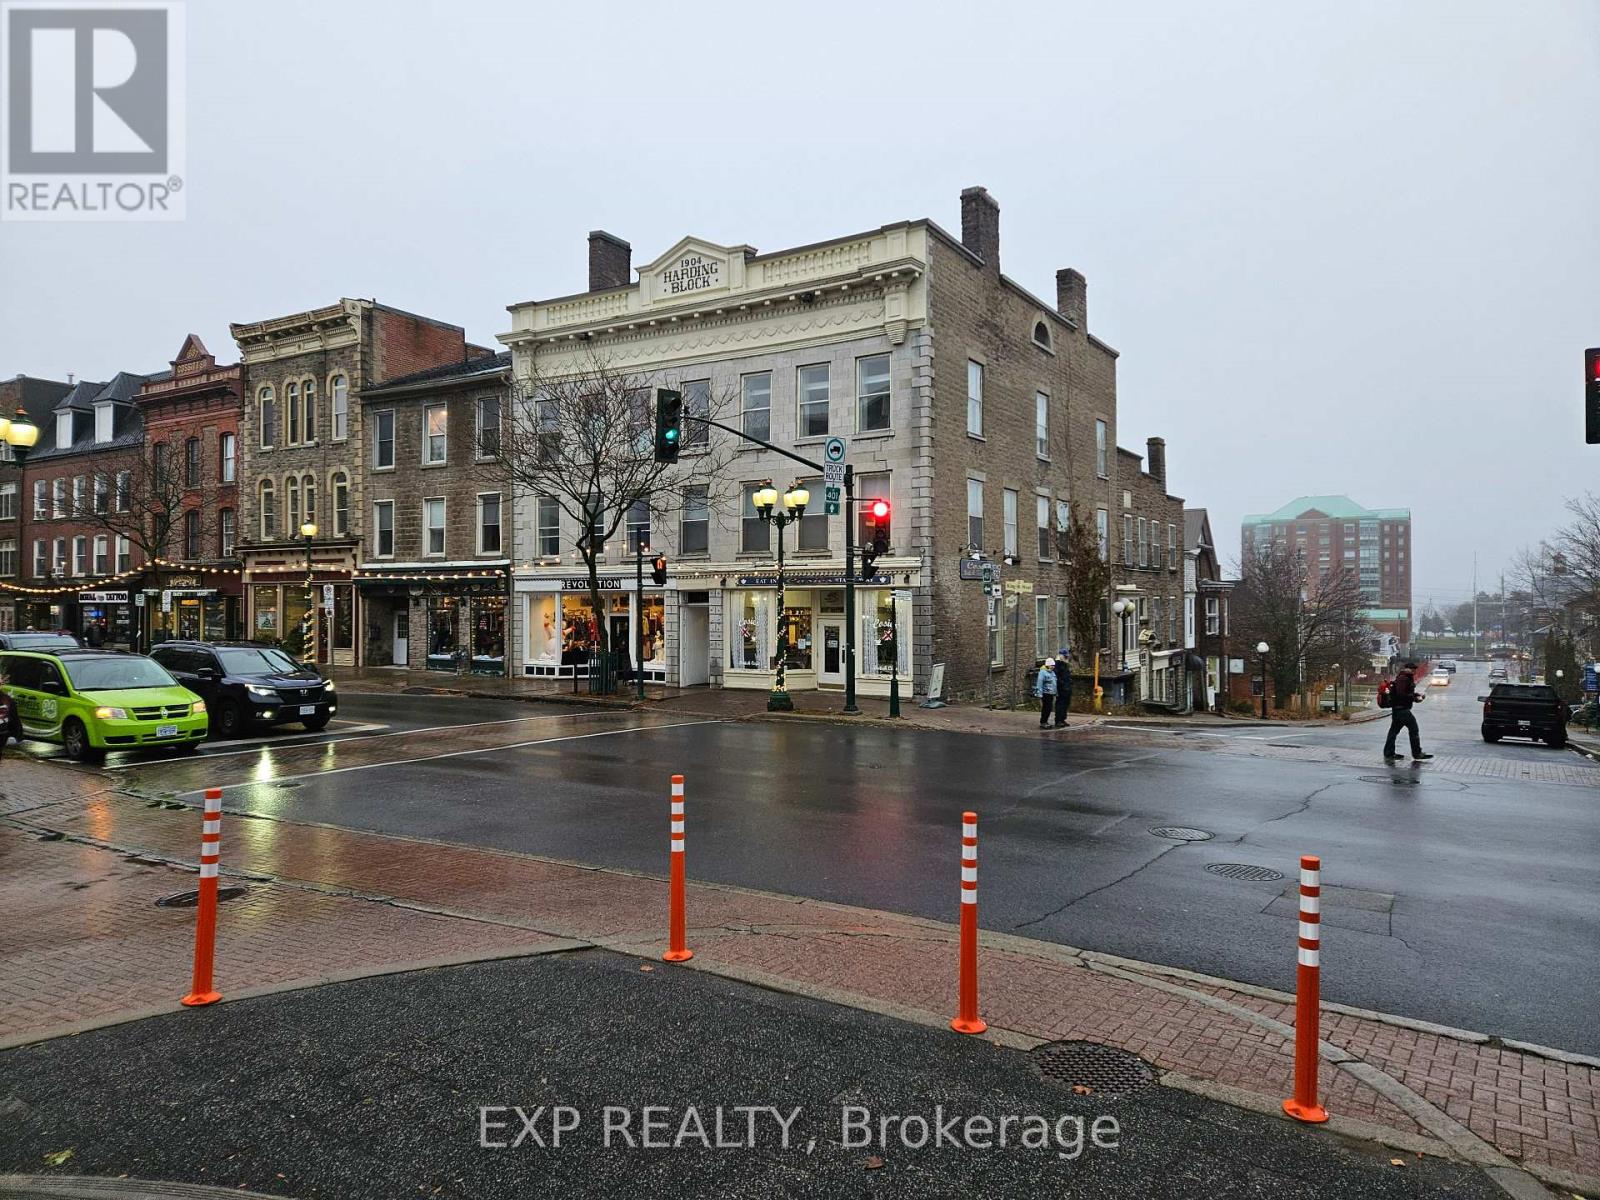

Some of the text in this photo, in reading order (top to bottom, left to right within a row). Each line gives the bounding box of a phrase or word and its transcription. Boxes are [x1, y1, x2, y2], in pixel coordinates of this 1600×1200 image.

[681, 256, 702, 268] 1904
[664, 261, 718, 284] HARDING
[671, 275, 711, 294] BLOCK
[826, 465, 843, 473] TRUCK
[827, 492, 838, 500] 401
[560, 579, 620, 589] REVOLTION
[105, 593, 127, 601] TATTOO
